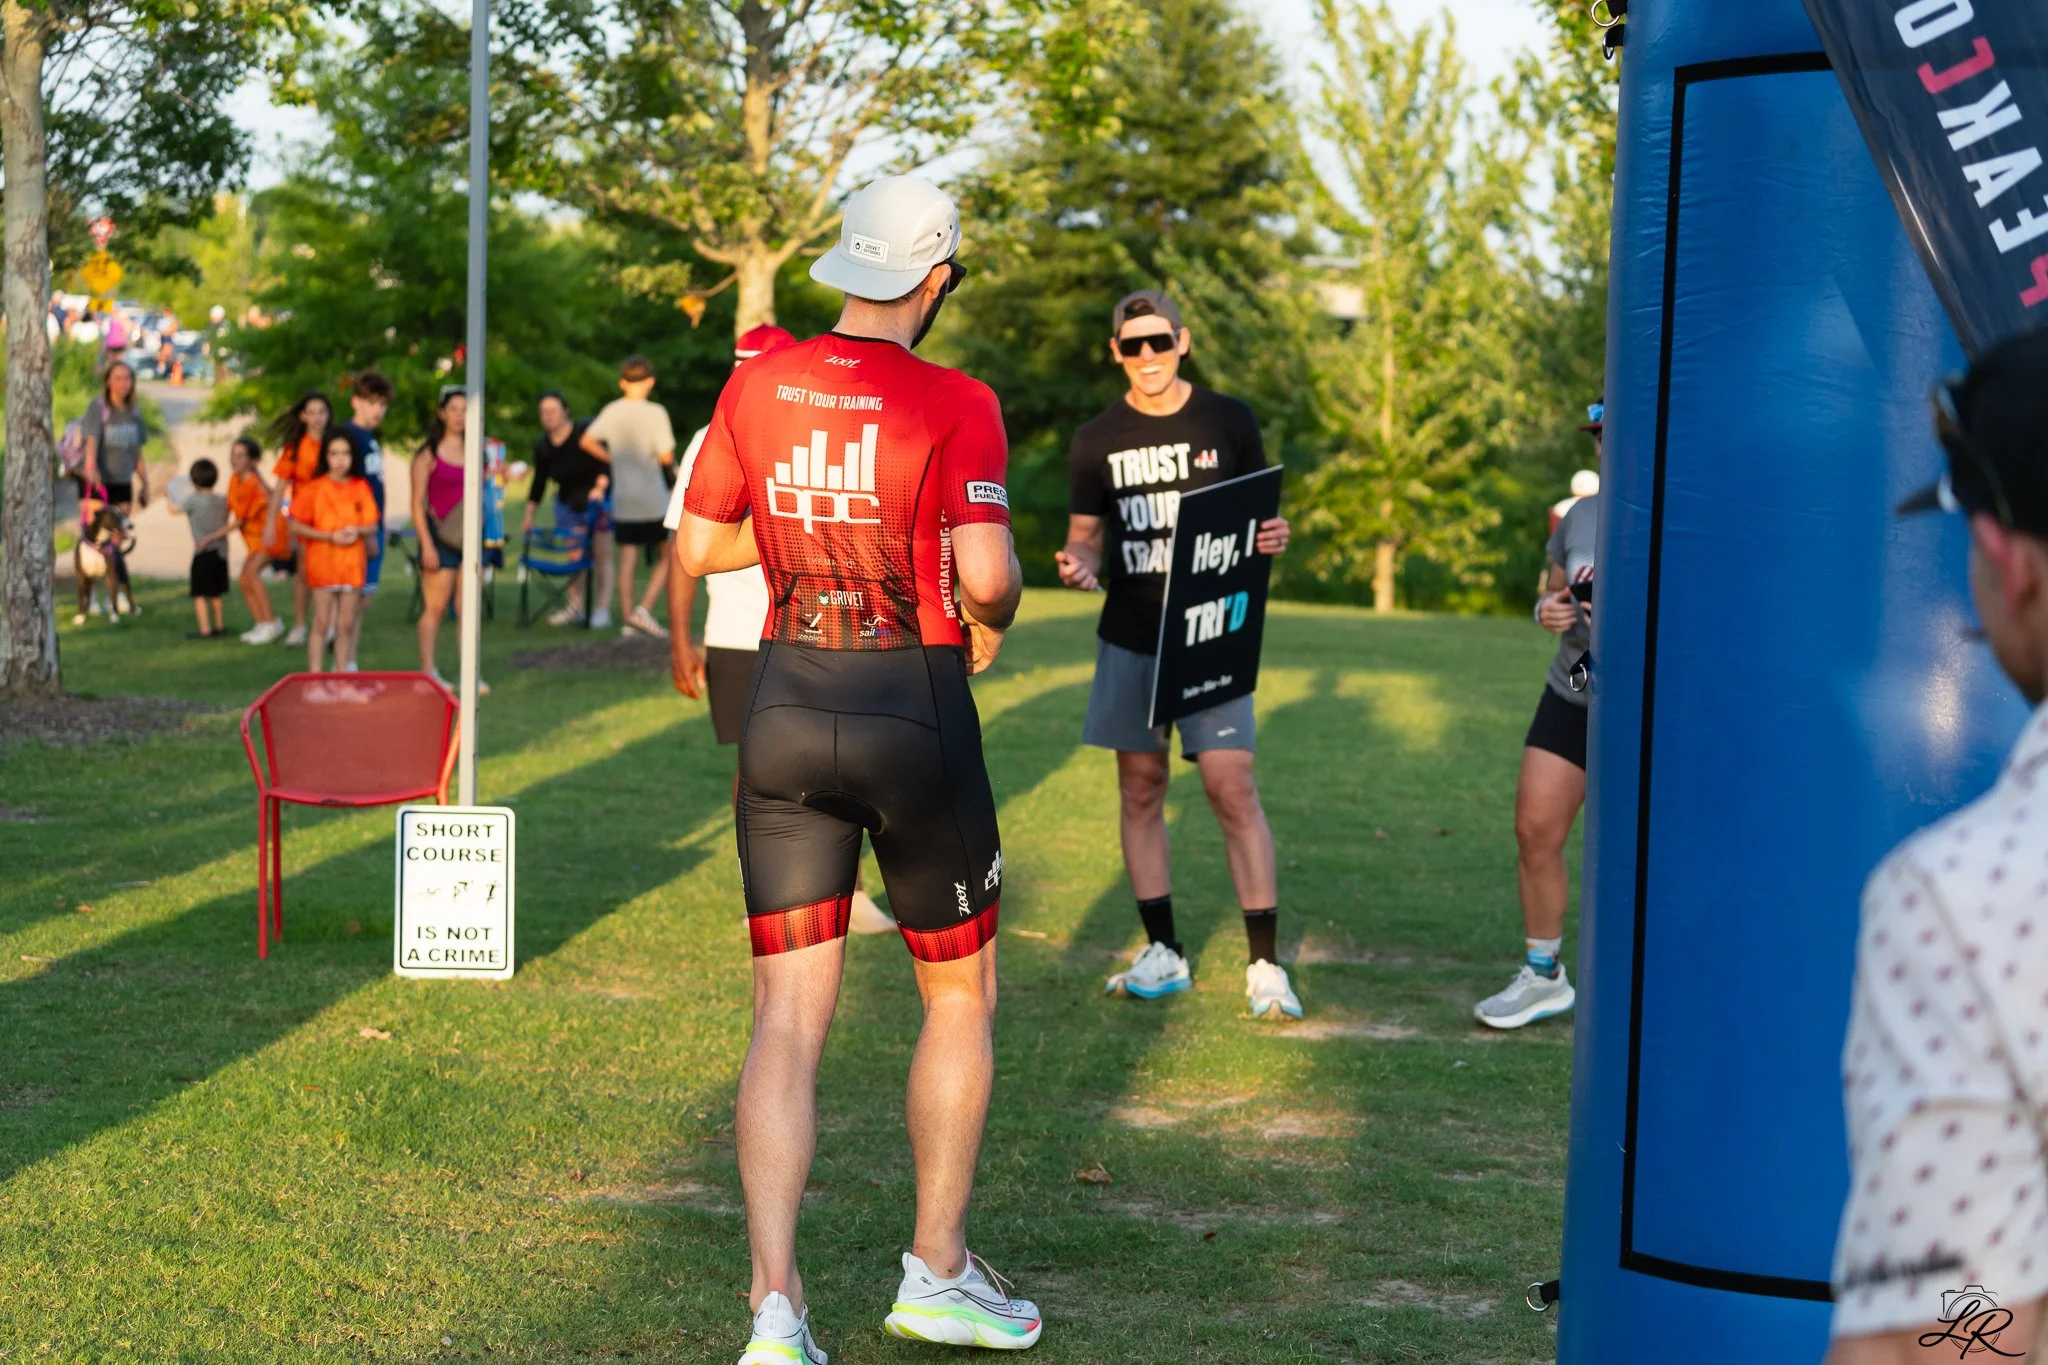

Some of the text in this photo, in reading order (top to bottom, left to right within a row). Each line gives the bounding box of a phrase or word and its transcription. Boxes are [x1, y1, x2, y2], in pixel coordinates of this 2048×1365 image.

[776, 385, 883, 411] TRUST YOUR TRAINING
[1107, 443, 1191, 489] TRUST
[1191, 518, 1256, 575] Hey, I
[830, 590, 864, 607] GRIVET
[416, 823, 496, 838] SHORT
[407, 847, 503, 863] COURSE
[417, 926, 493, 941] IS NOT
[407, 948, 501, 964] A CRIME
